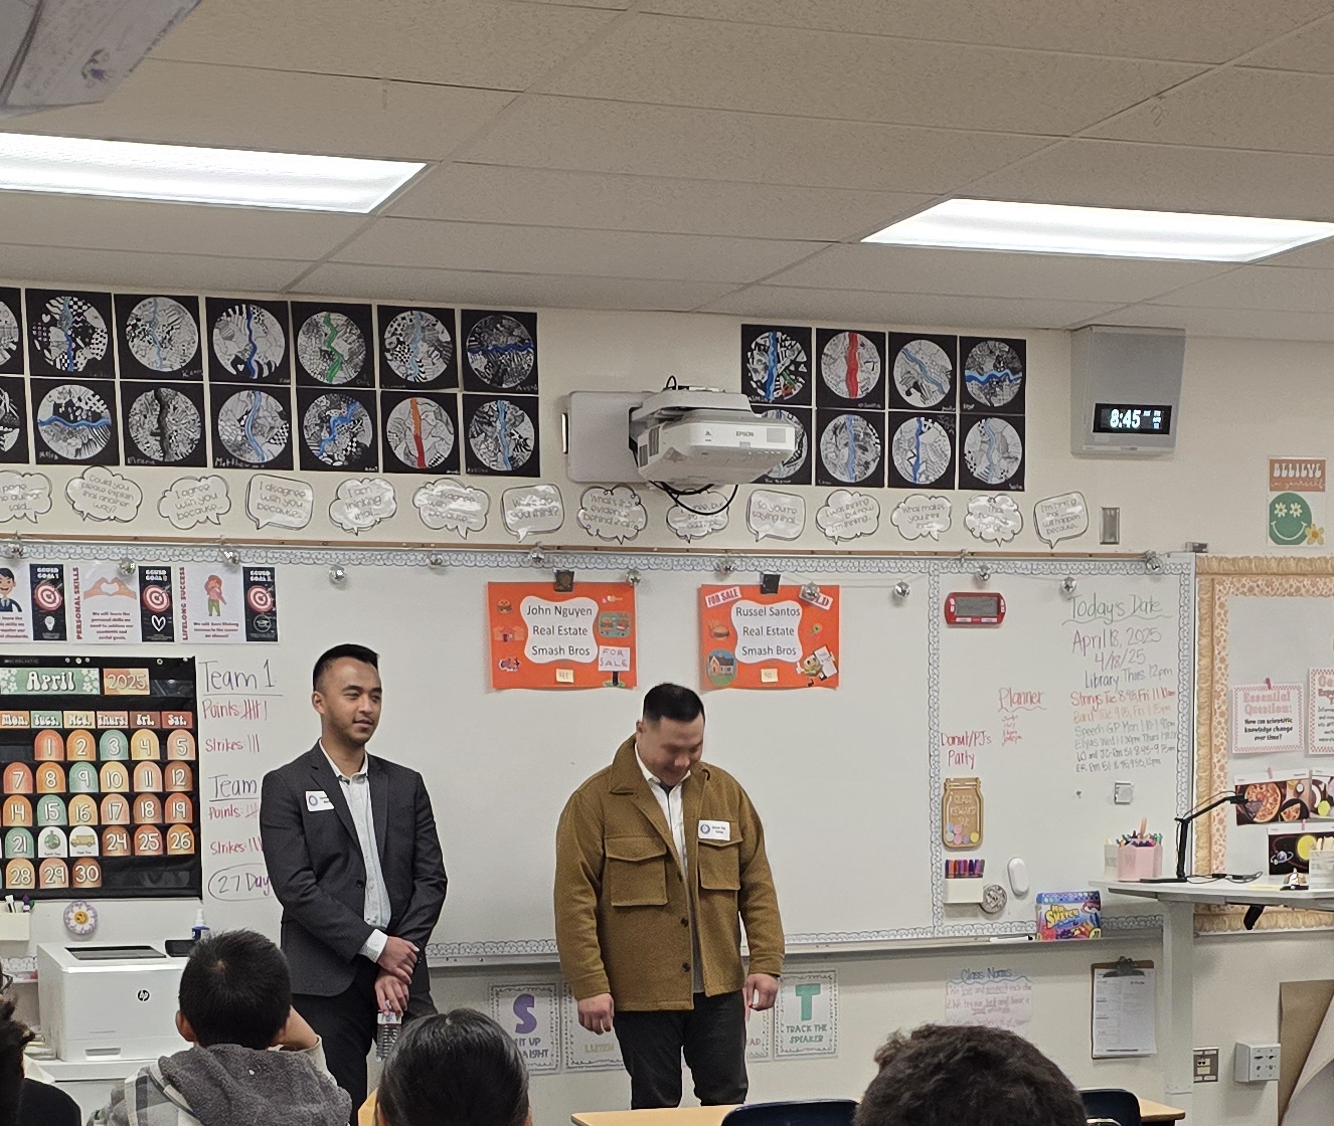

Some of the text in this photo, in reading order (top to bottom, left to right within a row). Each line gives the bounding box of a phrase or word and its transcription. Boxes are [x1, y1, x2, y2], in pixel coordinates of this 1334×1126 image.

[1109, 408, 1142, 429] 8:45
[1273, 461, 1323, 478] BELIEVE
[708, 588, 741, 605] FOR SALE
[1129, 593, 1163, 615] Date
[73, 596, 83, 640] PERSONAL
[527, 605, 593, 619] John Nguyen
[736, 605, 801, 617] Russel Santos
[532, 625, 589, 636] Real Estate
[742, 625, 795, 636] Real Estate
[531, 645, 591, 657] Smash Bros
[741, 645, 797, 657] Smash Bros
[1072, 629, 1106, 657] April
[1126, 626, 1162, 646] 2025
[599, 656, 629, 668] SALE
[602, 647, 625, 658] FOR
[26, 671, 147, 692] April 2025
[199, 659, 276, 693] Team 1
[1085, 670, 1120, 691] Library
[998, 687, 1045, 709] Planner
[1, 713, 29, 726] Mon.
[97, 713, 128, 726] Thurs.
[168, 714, 187, 726] Sat.
[948, 749, 975, 769] Party
[208, 774, 258, 799] Team
[12, 831, 191, 853] 21 24 25 26
[10, 866, 31, 885] 28
[43, 866, 65, 884] 29
[75, 864, 99, 883] 30
[218, 874, 241, 893] 27
[795, 983, 822, 1021] T
[512, 993, 538, 1035] S
[786, 1023, 828, 1035] TRACK THE
[789, 1033, 824, 1044] SPEAKER
[528, 1037, 541, 1046] UP
